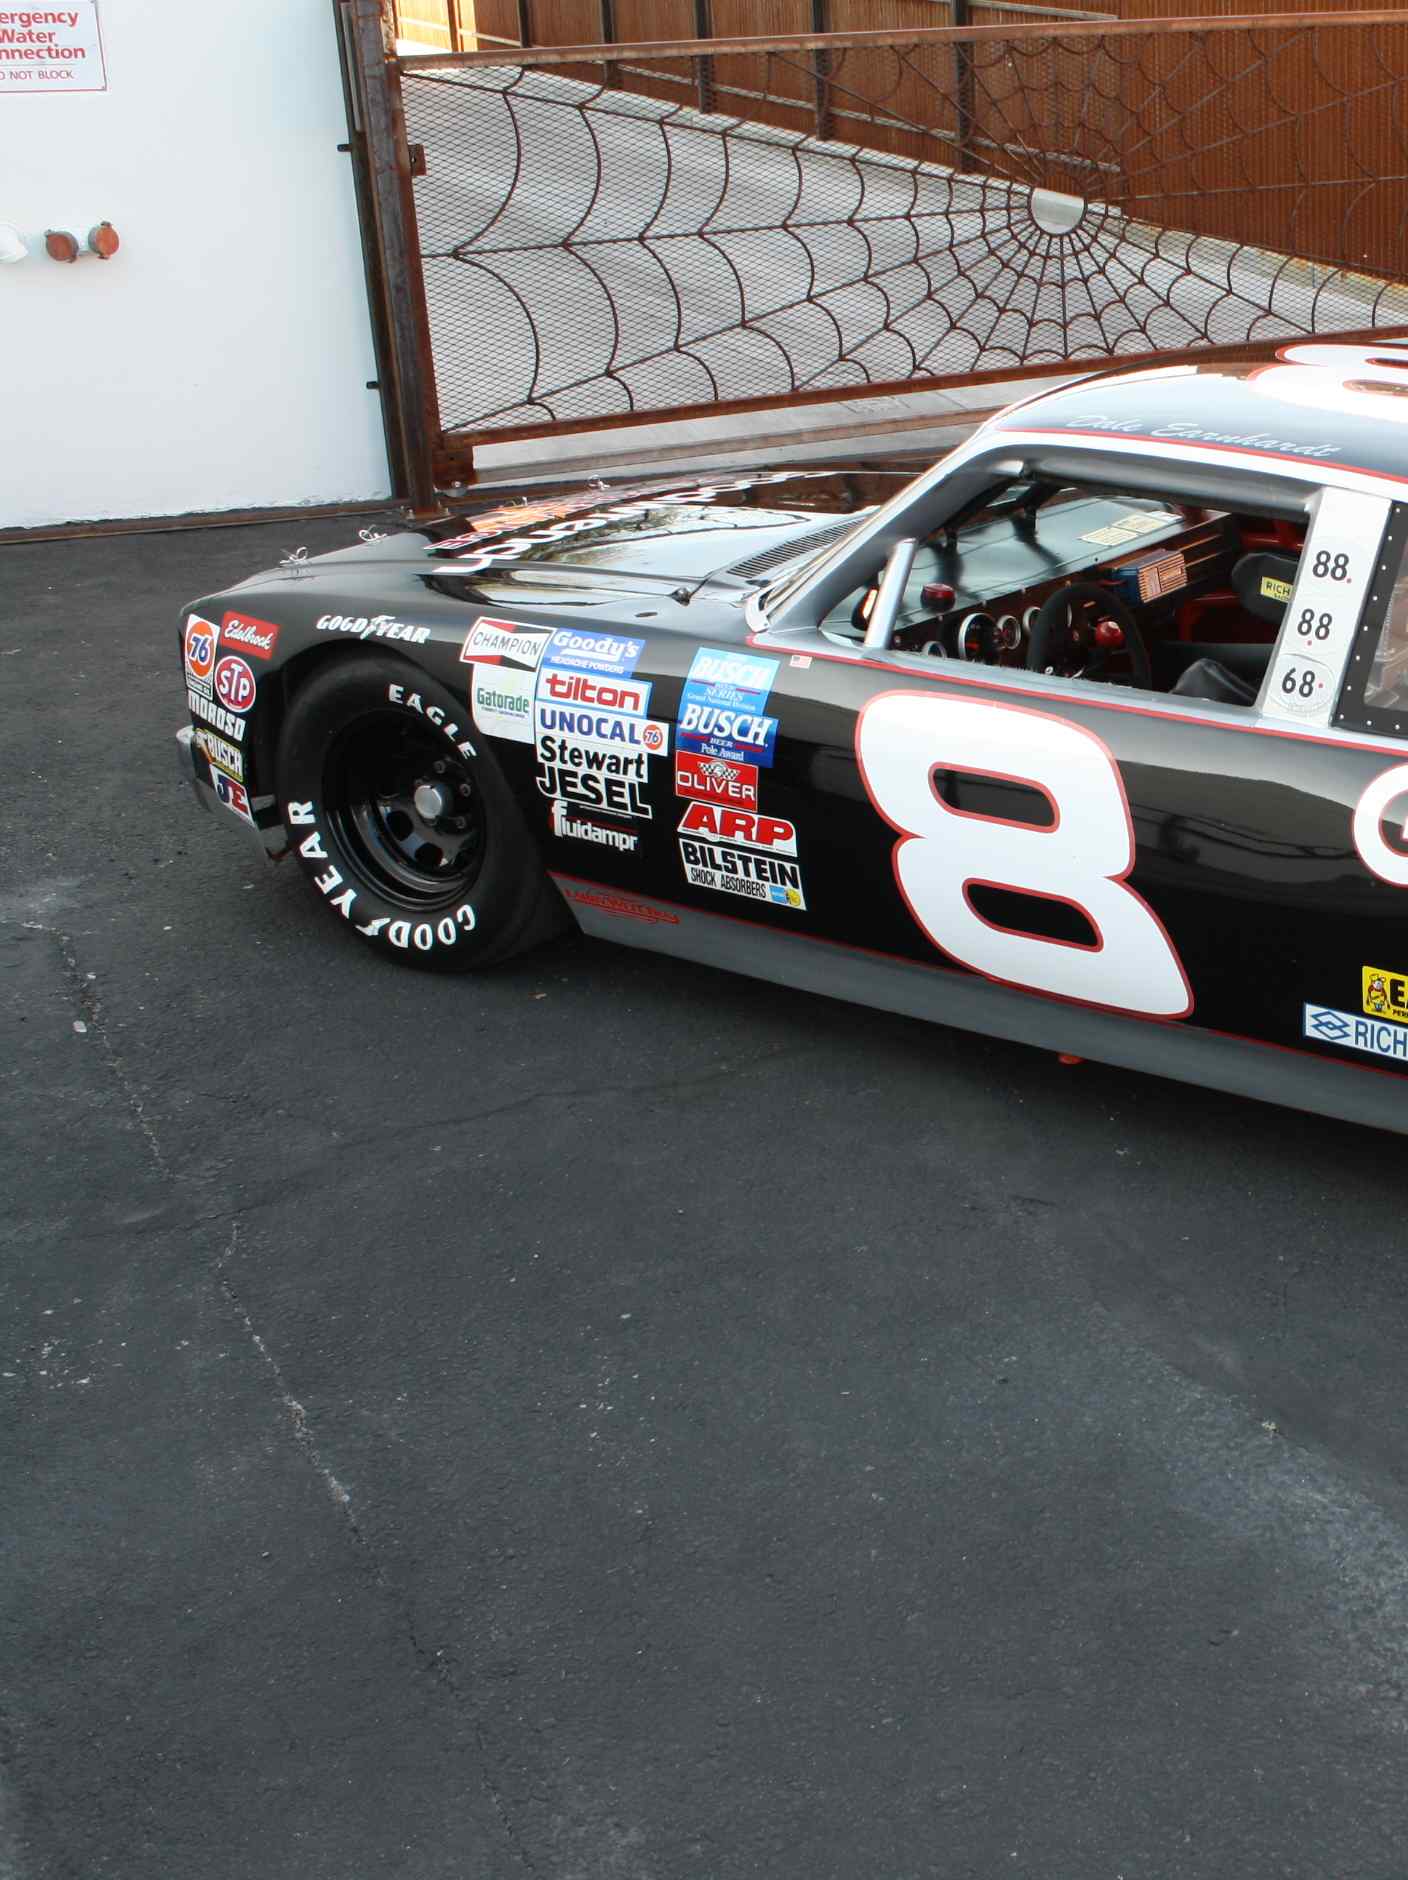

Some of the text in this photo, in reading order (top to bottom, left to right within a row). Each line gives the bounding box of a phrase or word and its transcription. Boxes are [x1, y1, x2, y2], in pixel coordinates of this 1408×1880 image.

[10, 71, 33, 80] NOT
[38, 70, 74, 79] BLOCK
[1066, 415, 1341, 457] Dale Earnhardt
[225, 619, 274, 650] Edelbrock
[316, 614, 431, 644] GOODYEAR
[1297, 608, 1333, 641] 88
[189, 633, 211, 665] 76
[473, 631, 541, 657] CHAMPION
[552, 631, 639, 662] Goody's
[219, 662, 251, 702] STP
[477, 687, 530, 714] Gatorade
[545, 673, 641, 711] tilton
[1281, 667, 1316, 698] 68
[187, 688, 246, 741] MOROSO
[388, 683, 478, 760] EAGLE
[540, 708, 642, 745] UNOCAL
[643, 730, 661, 744] 76
[680, 703, 773, 746] BUSCH
[540, 735, 645, 779] Stewart
[700, 742, 745, 761] Pole Award
[539, 765, 651, 816] JESEL
[677, 771, 755, 800] OLIVER
[552, 799, 638, 851] fluidampr
[682, 803, 794, 846] ARP
[682, 841, 800, 889] BILSTEIN
[855, 690, 1195, 1019] 8
[287, 799, 477, 951] GOODYEAR
[690, 867, 767, 898] SHOCK ABSORBERS
